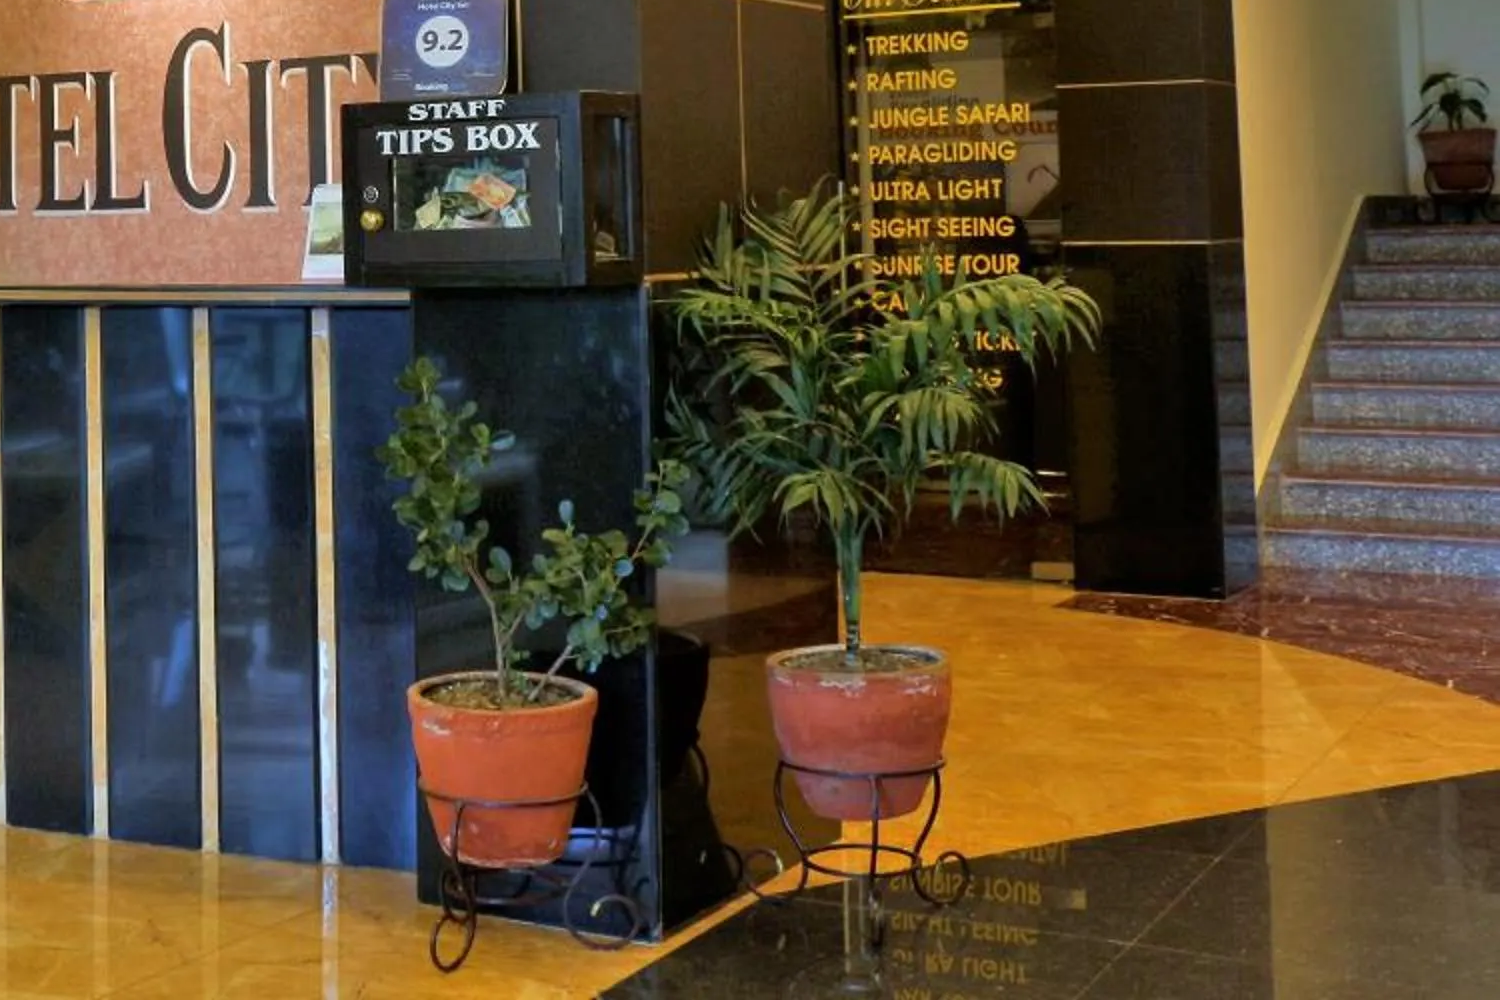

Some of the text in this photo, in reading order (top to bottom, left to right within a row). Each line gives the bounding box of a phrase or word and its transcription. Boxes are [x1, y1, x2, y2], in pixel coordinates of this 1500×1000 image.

[421, 29, 463, 53] 9.2
[865, 30, 970, 56] TREKKING
[867, 67, 958, 91] RAFTING
[163, 21, 378, 215] CIT
[408, 99, 507, 121] STAFF
[869, 103, 1030, 129] JUNGLE SAFARI
[375, 121, 541, 155] TIPS BOX
[869, 140, 1018, 165] PARAGLIDING
[869, 178, 1003, 201] ULTRA LIGHT
[869, 216, 1016, 239] SIGHT SEEING
[871, 253, 1021, 276] SUNRSE TOUR
